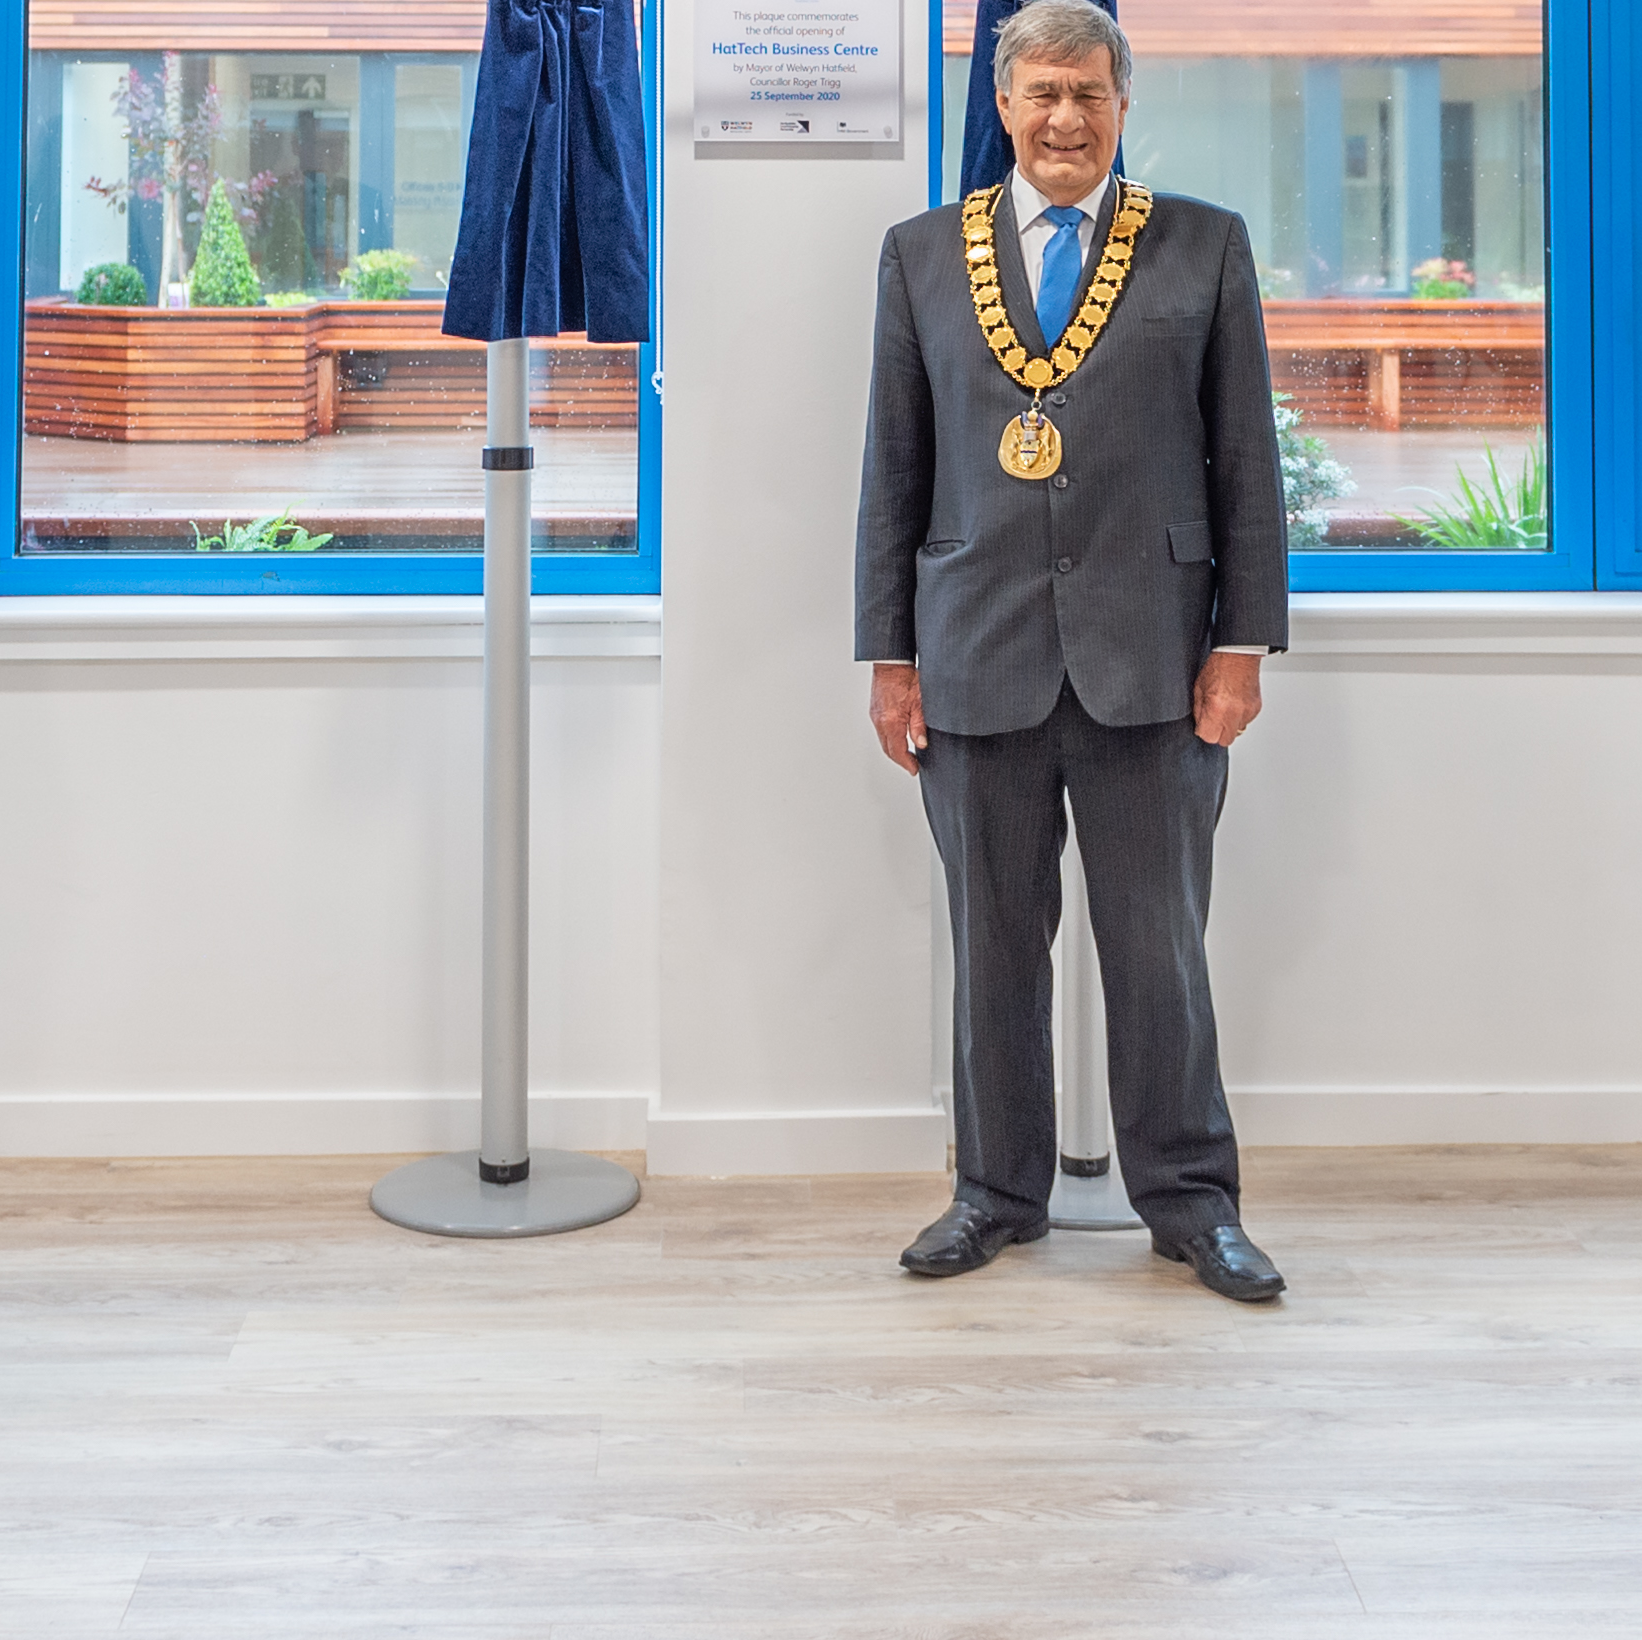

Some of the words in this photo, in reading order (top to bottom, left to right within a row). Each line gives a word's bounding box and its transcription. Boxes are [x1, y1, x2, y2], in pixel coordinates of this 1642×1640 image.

[733, 11, 751, 21] This
[754, 12, 785, 23] plaque
[787, 12, 859, 21] commemorates
[746, 26, 761, 35] the
[763, 26, 793, 36] official
[796, 27, 833, 38] opening
[836, 26, 845, 36] of
[713, 42, 767, 55] HatTech
[773, 43, 829, 56] Business
[834, 44, 878, 56] Centre
[733, 63, 743, 73] by
[745, 64, 772, 73] Mayor
[775, 63, 784, 72] of
[786, 64, 818, 73] Welwyn
[750, 78, 791, 86] Councillor
[793, 78, 817, 88] Roger
[820, 78, 841, 88] Trigg
[750, 92, 761, 100] 25
[765, 91, 814, 102] September
[817, 92, 840, 100] 2020
